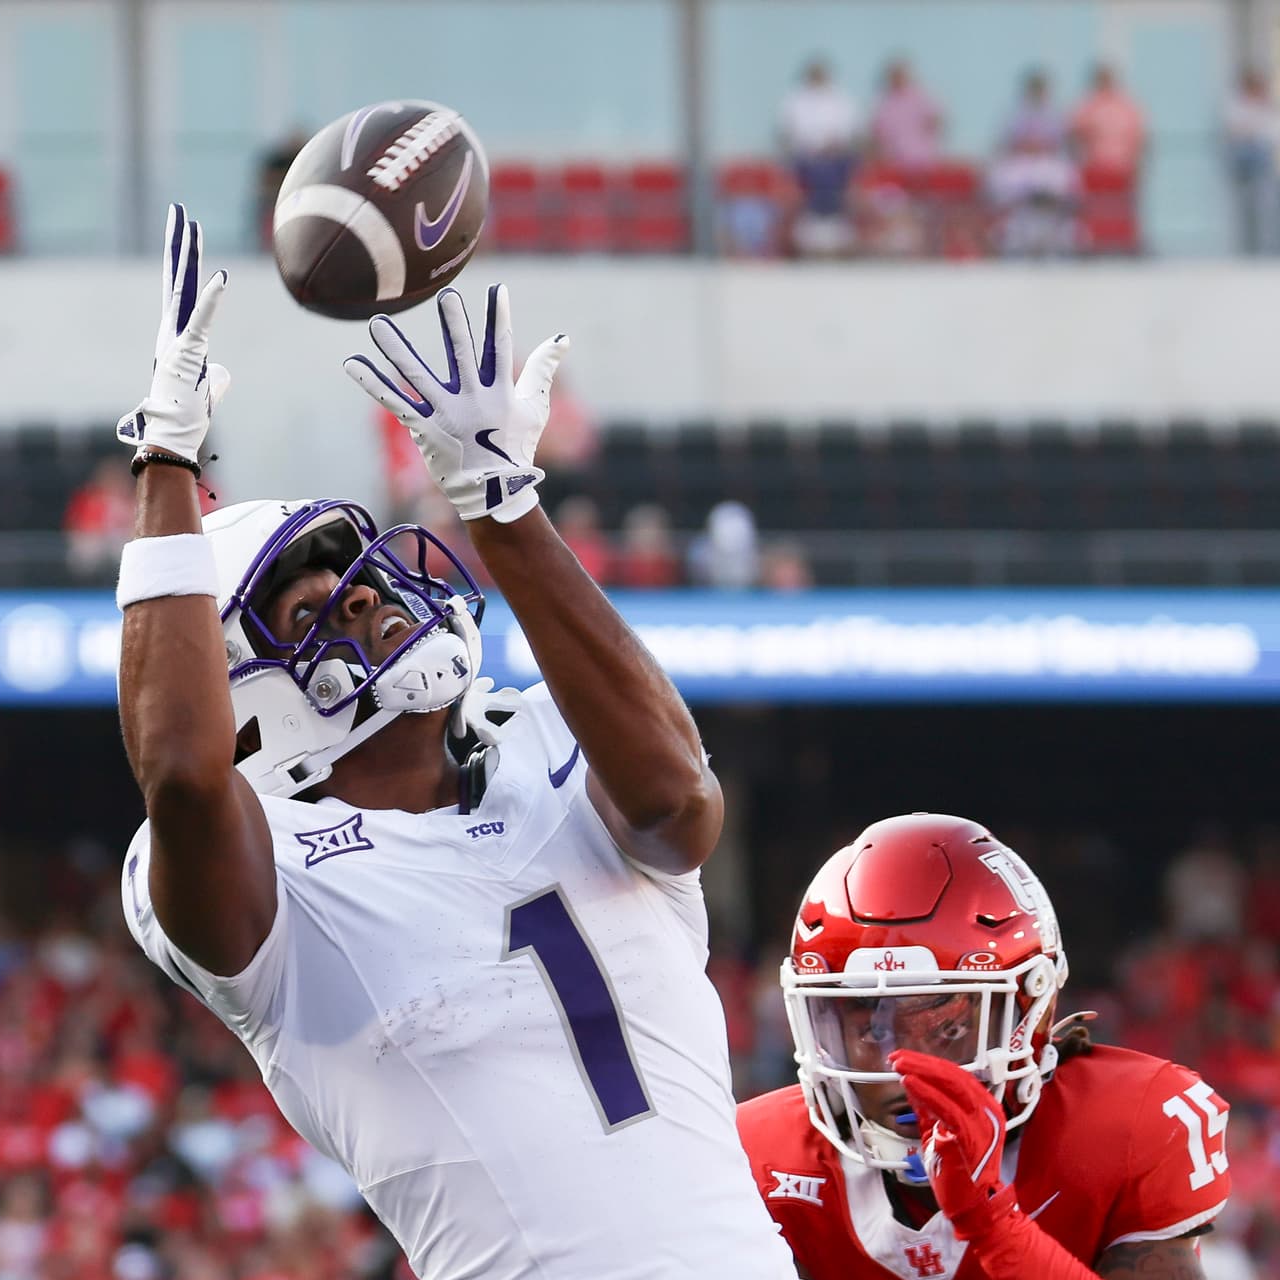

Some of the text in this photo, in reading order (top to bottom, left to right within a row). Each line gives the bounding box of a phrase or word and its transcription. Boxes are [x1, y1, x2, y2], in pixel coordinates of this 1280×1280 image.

[466, 821, 504, 839] TCU
[501, 882, 658, 1135] 1
[1162, 1080, 1229, 1191] 15
[768, 1170, 827, 1207] XII
